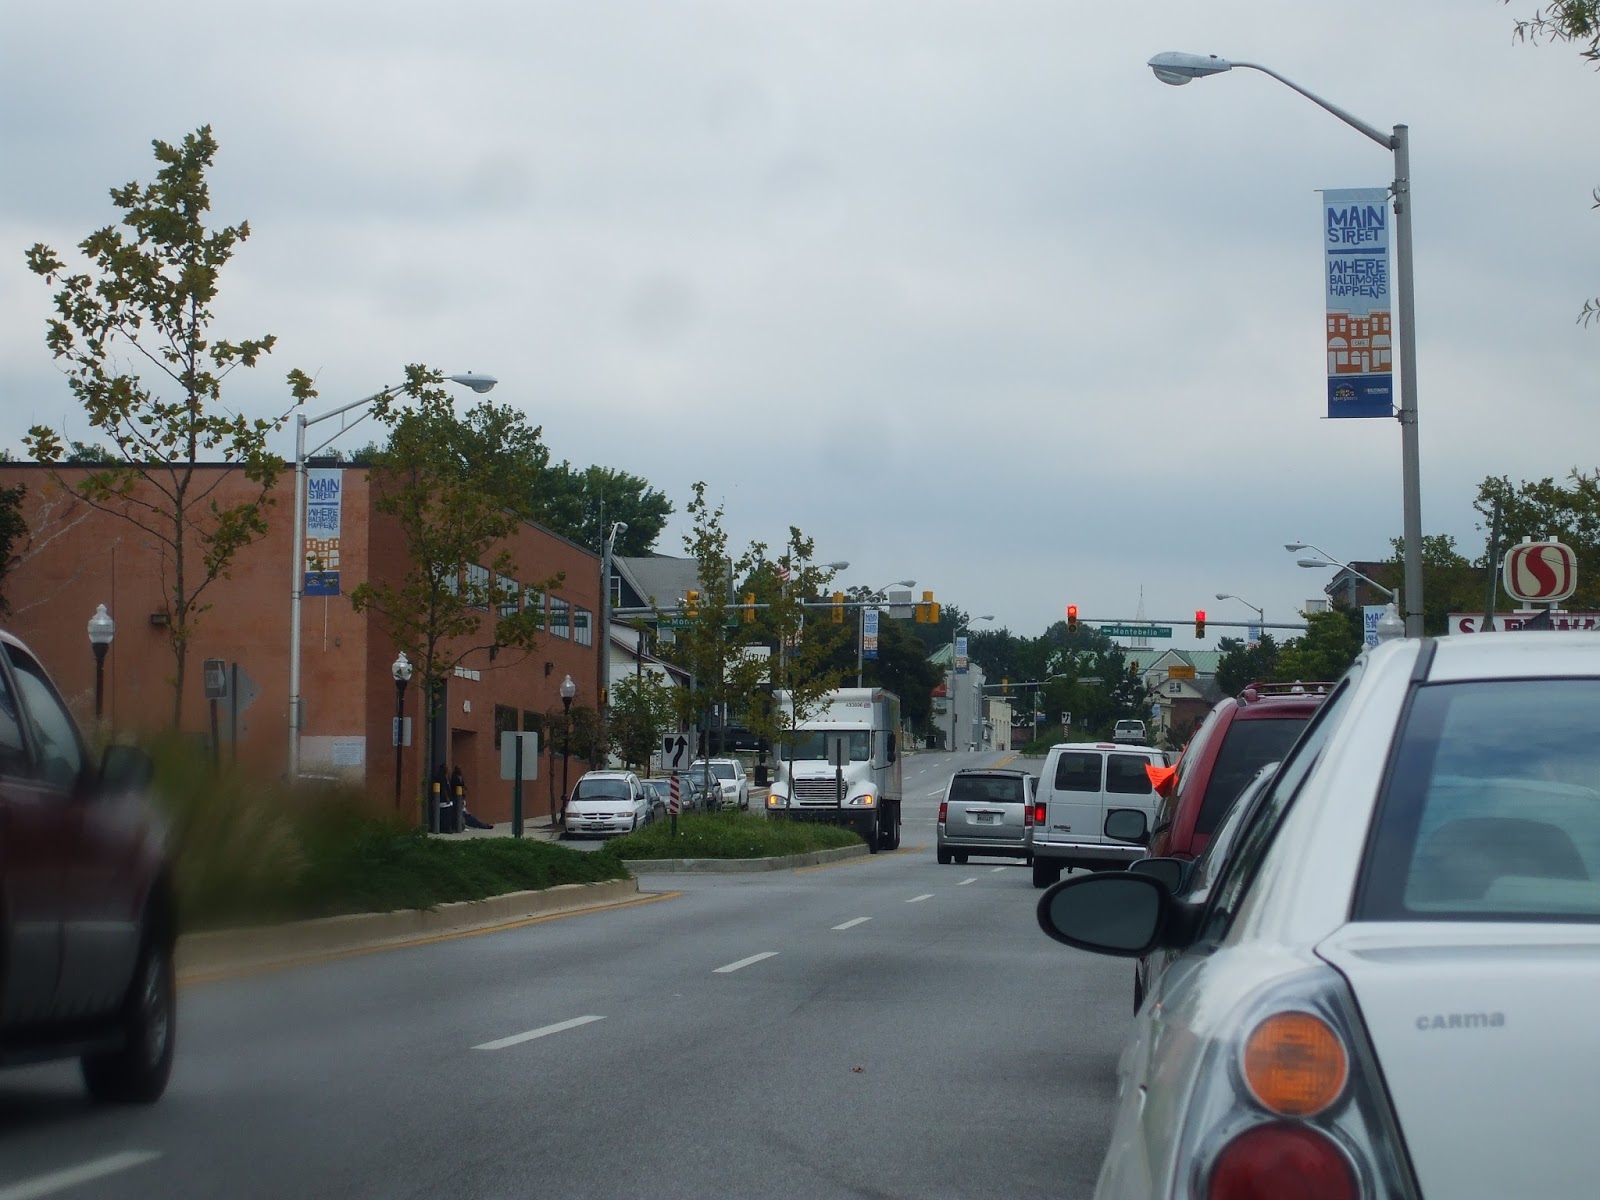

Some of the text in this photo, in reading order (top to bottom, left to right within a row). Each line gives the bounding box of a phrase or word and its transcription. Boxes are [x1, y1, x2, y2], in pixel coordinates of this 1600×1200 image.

[1328, 206, 1384, 228] MAIN
[1328, 227, 1384, 245] STREET
[1329, 259, 1386, 276] WHERE
[1330, 273, 1386, 287] BALTIMORE
[1330, 284, 1387, 299] HAPPENS
[309, 478, 339, 491] MAIN
[309, 490, 339, 501] STREET
[308, 507, 338, 519] WHERE
[1113, 627, 1158, 636] Montebello
